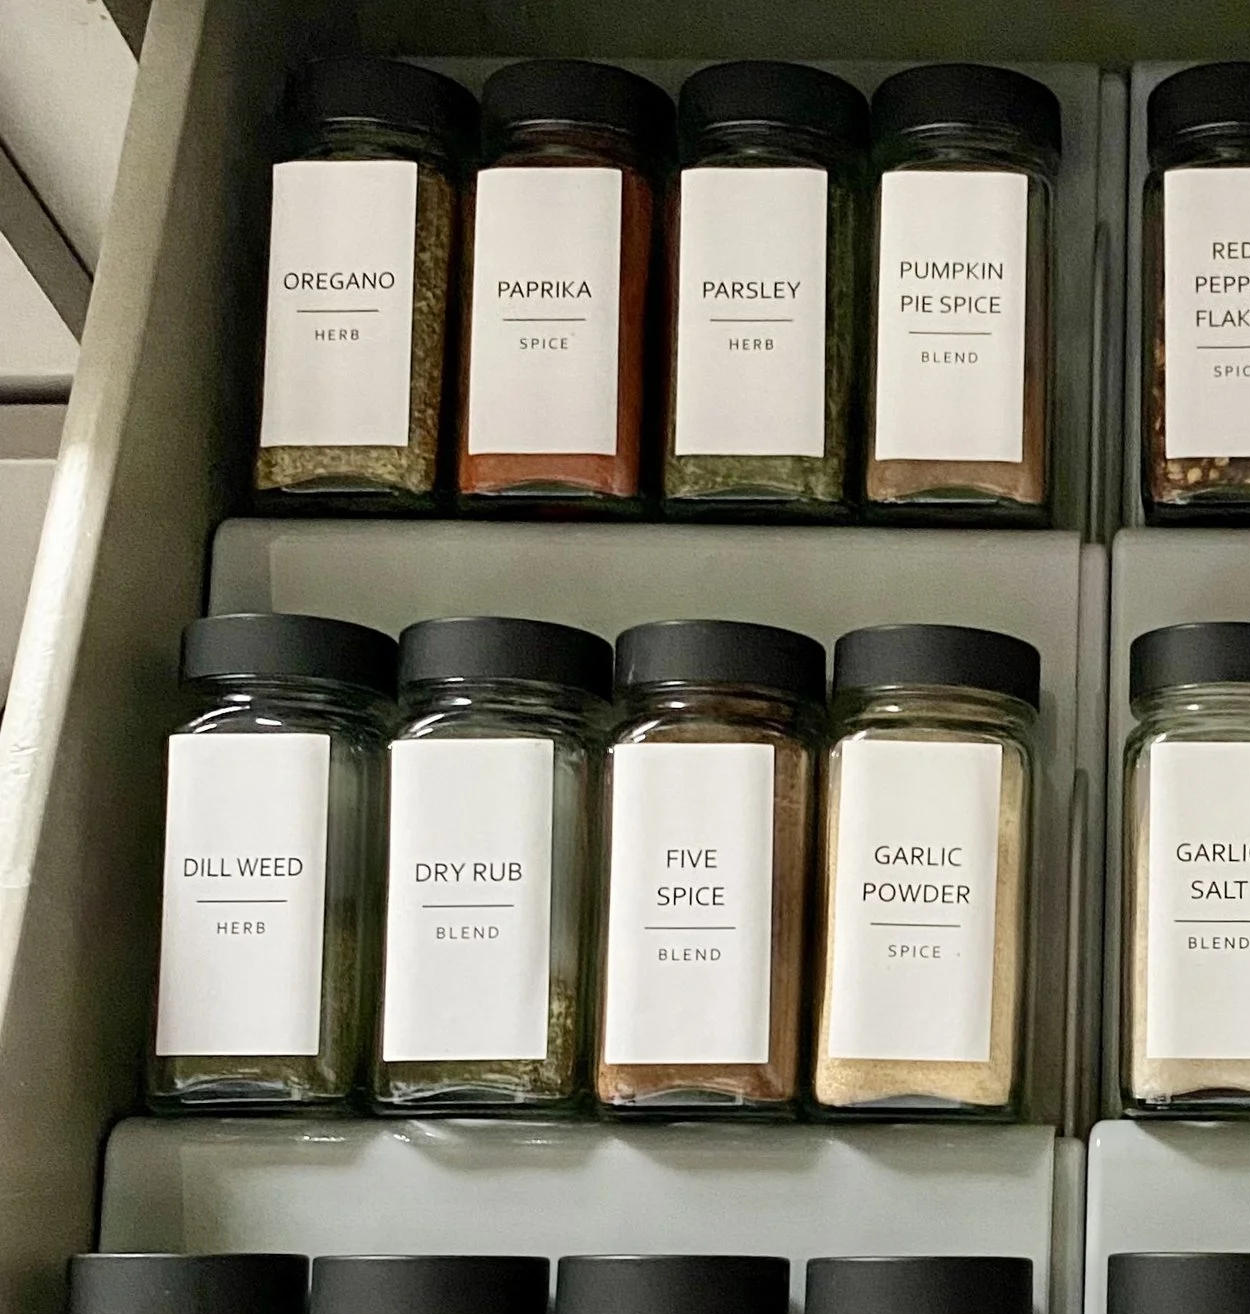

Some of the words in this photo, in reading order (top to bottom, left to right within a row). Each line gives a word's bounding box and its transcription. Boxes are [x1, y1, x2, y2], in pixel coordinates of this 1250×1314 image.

[282, 270, 396, 291] OREGANO
[899, 260, 1004, 281] PUMPKIN
[497, 280, 593, 300] PAPRIKA
[702, 280, 802, 300] PARSLEY
[900, 294, 934, 314] PIE
[939, 295, 1002, 315] SPICE
[314, 327, 360, 342] HERB
[519, 337, 569, 351] SPICE
[728, 337, 774, 351] HERB
[921, 350, 979, 364] BLEND
[666, 848, 718, 869] FIVE
[874, 844, 963, 868] GARLIC
[183, 857, 233, 878] DILL
[236, 856, 304, 878] WEED
[415, 862, 467, 883] DRY
[472, 861, 523, 883] RUB
[656, 885, 726, 907] SPICE
[862, 881, 971, 905] POWDER
[1190, 879, 1249, 900] SALT
[216, 921, 266, 936] HERB
[435, 925, 500, 940] BLEND
[887, 944, 941, 959] SPICE
[1187, 936, 1250, 950] BLEND
[657, 947, 722, 962] BLEND
